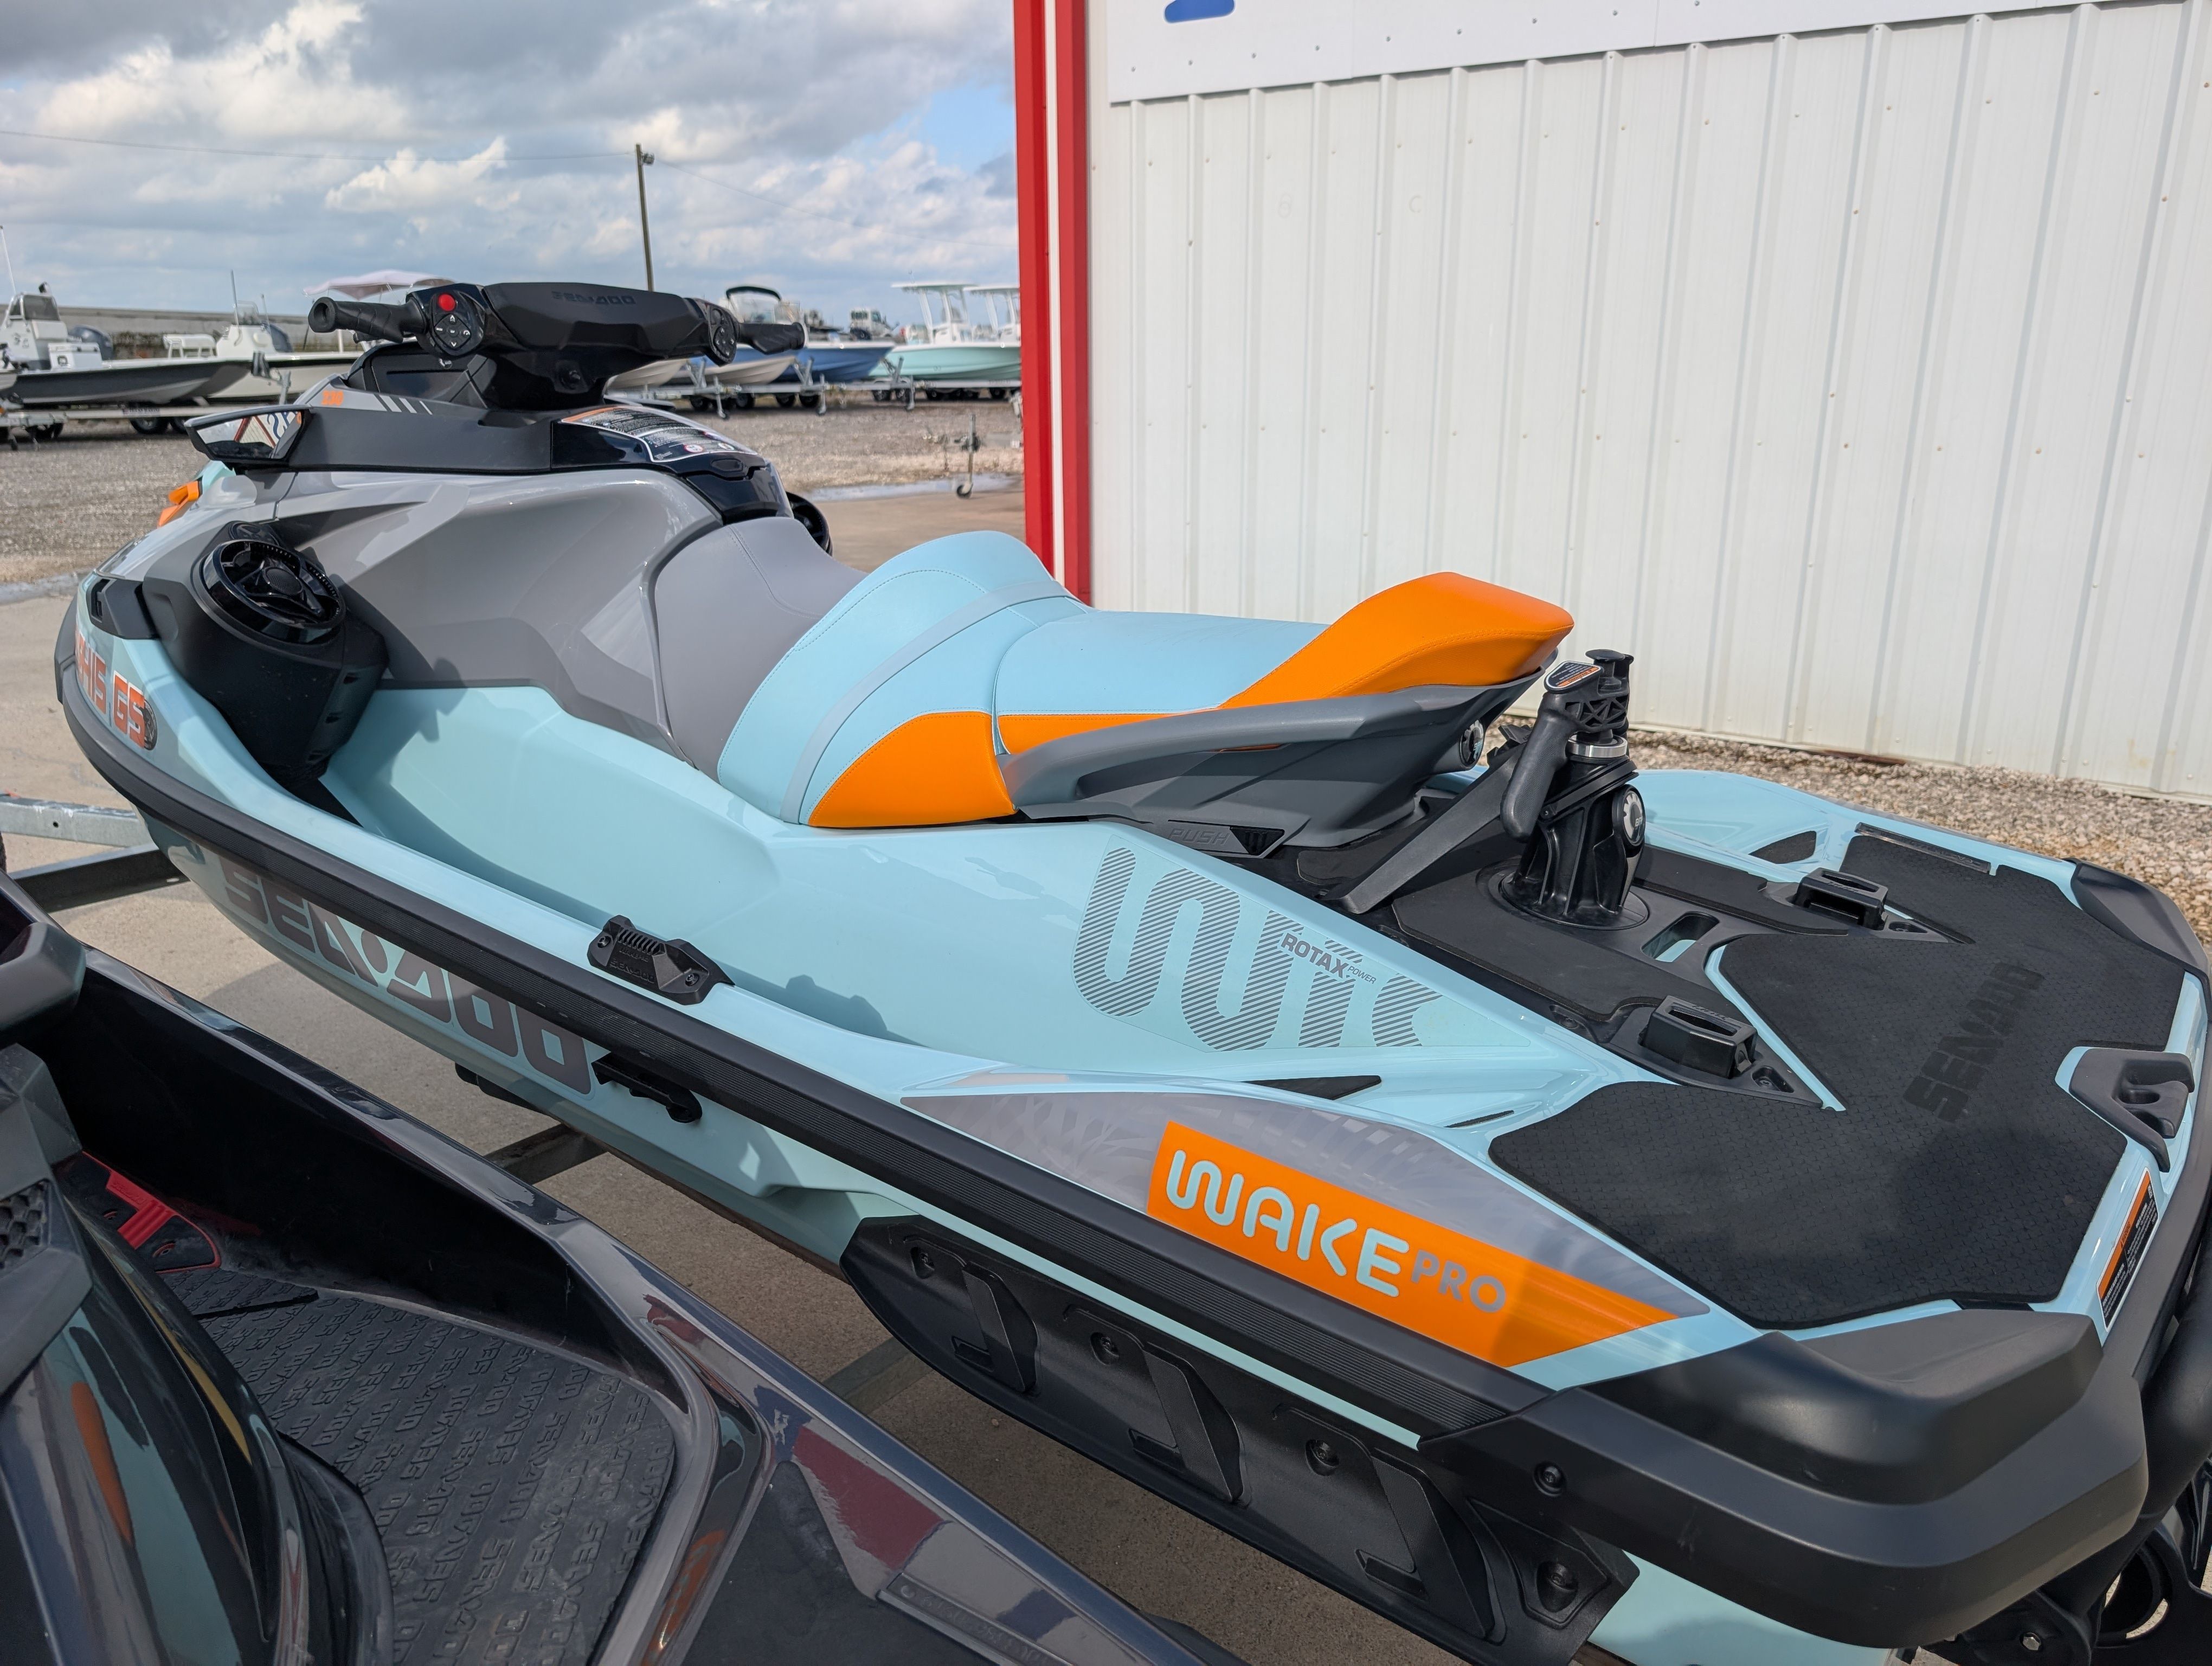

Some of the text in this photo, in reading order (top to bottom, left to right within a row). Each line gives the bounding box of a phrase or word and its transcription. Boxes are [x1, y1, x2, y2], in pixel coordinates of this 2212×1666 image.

[1168, 828, 1231, 845] PUSH
[1281, 932, 1377, 984] ROTAX POWER
[1166, 1149, 1507, 1313] WAKE PRO
